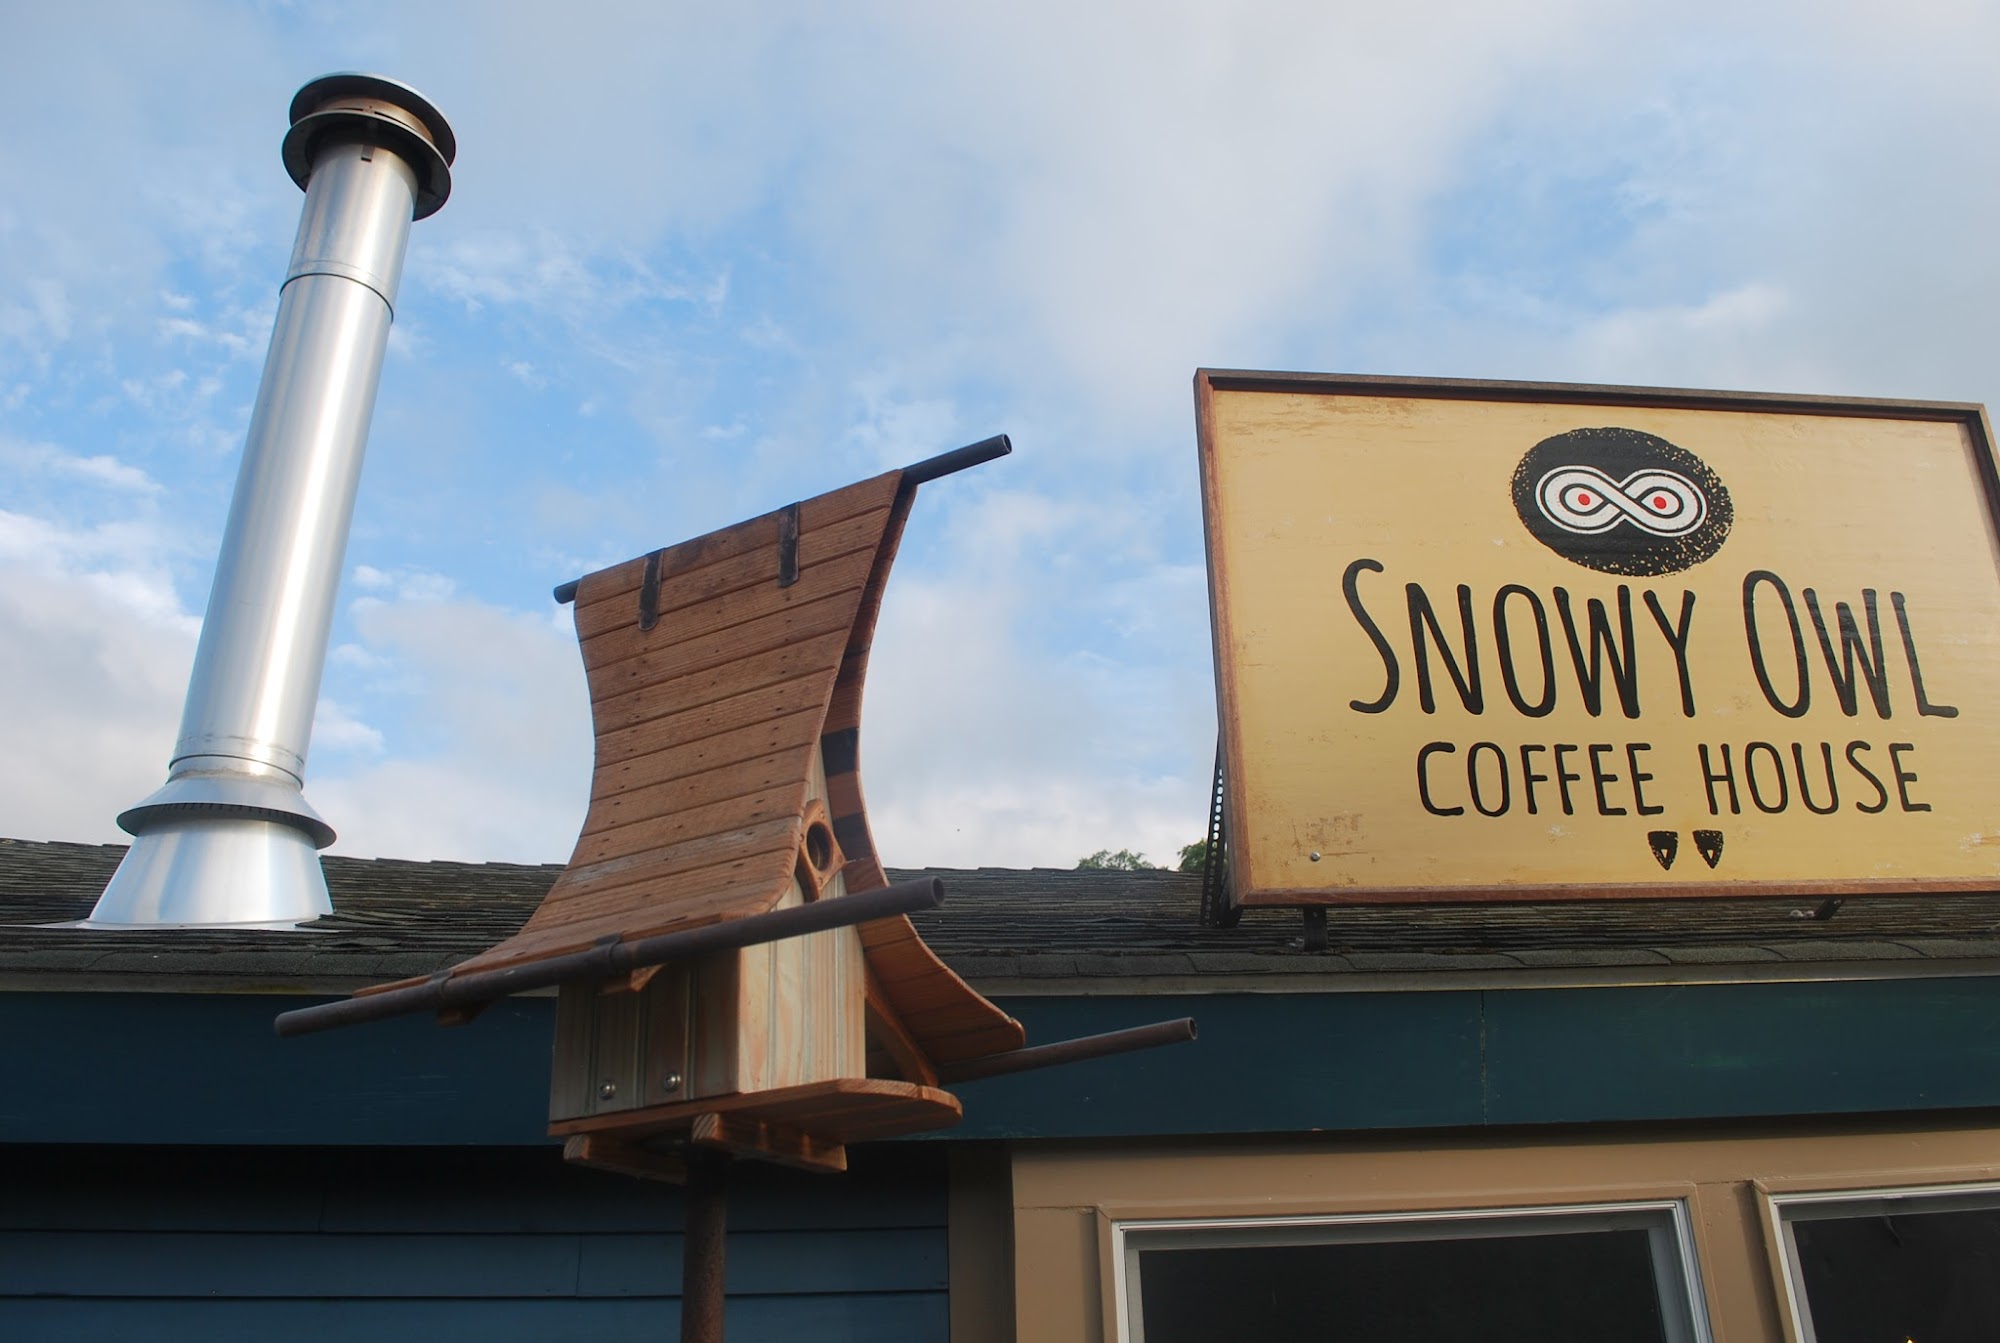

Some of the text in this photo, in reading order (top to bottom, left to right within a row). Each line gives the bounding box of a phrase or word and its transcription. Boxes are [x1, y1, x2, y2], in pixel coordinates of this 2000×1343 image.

[1342, 558, 1959, 720] SNOWY OWL
[1416, 740, 1932, 817] COFFEE HOUSE
